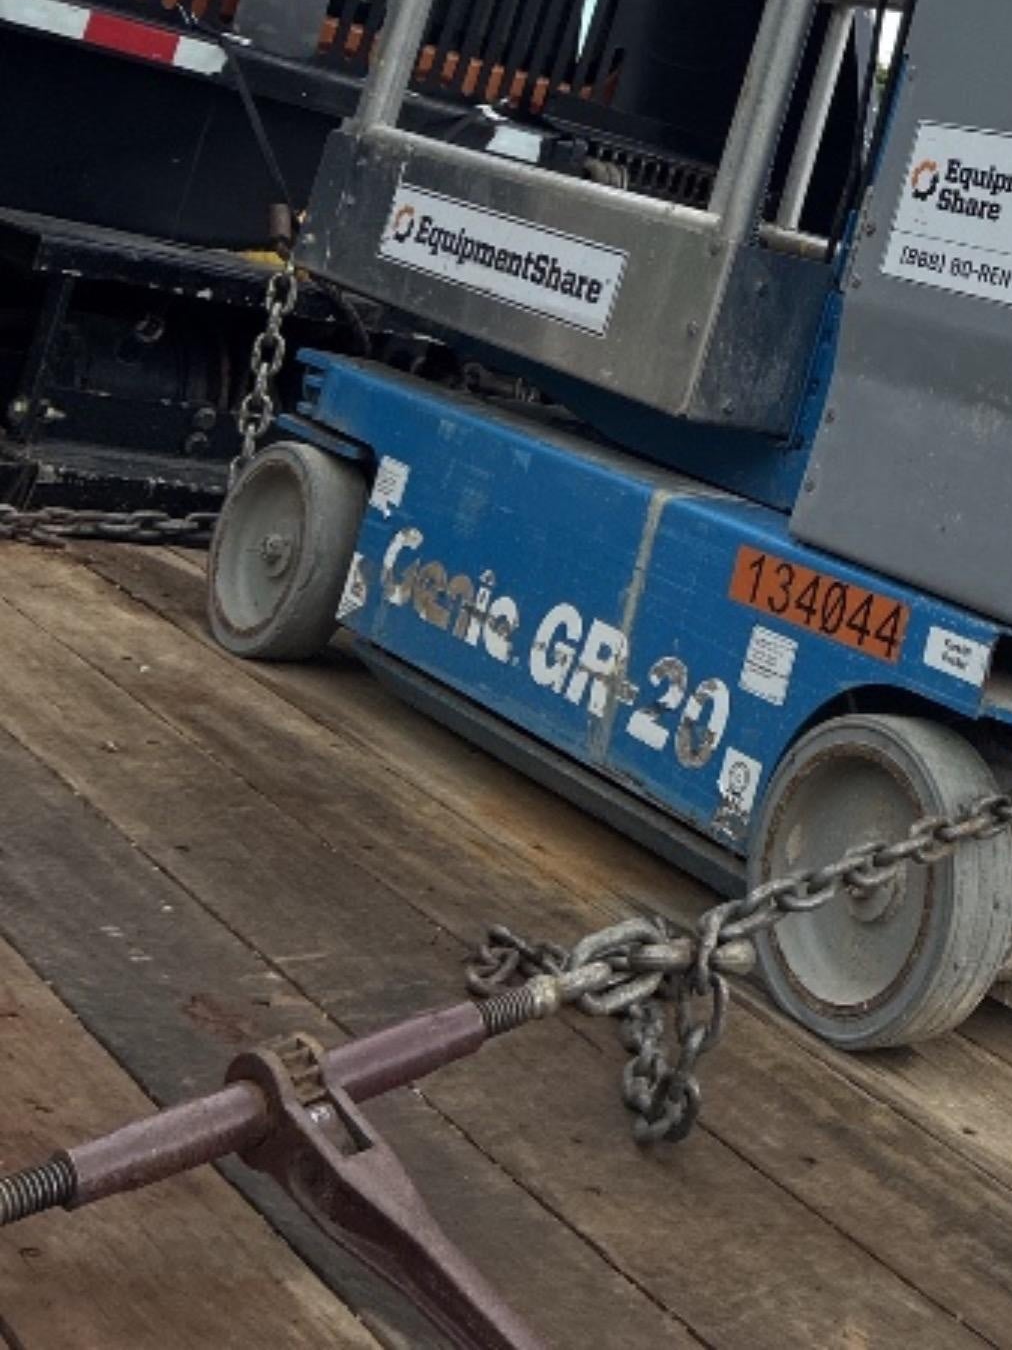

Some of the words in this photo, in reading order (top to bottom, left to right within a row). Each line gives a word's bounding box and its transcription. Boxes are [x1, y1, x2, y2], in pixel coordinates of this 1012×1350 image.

[936, 187, 1001, 221] Share
[414, 215, 601, 304] EquipmentShare
[379, 527, 520, 664] Genie
[529, 601, 731, 769] GR-20
[749, 553, 905, 658] 134044
